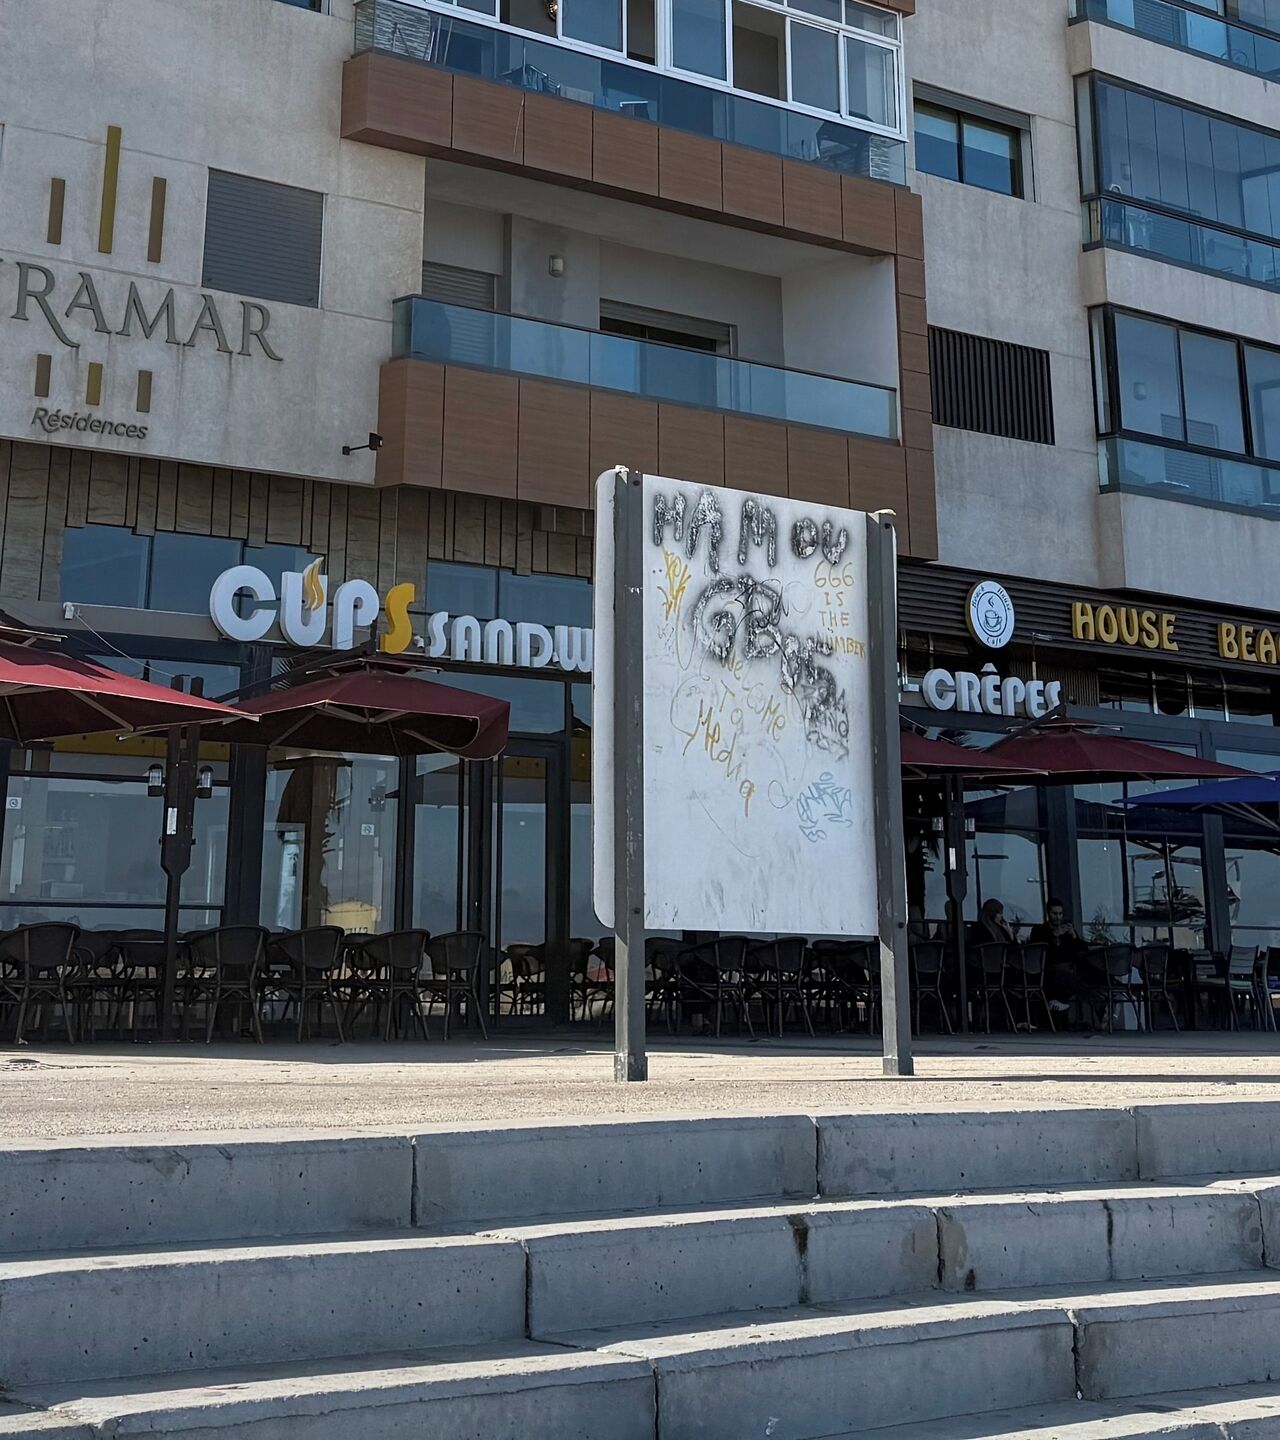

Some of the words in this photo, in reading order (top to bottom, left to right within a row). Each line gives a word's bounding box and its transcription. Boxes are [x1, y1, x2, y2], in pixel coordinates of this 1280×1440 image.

[31, 407, 149, 440] Résidences
[814, 559, 854, 588] 666
[209, 556, 416, 655] CUPS
[428, 611, 593, 673] SANDW
[823, 591, 844, 607] IS
[818, 611, 850, 627] THE
[1072, 601, 1179, 651] HOUSE
[922, 662, 1061, 718] CRÊPES
